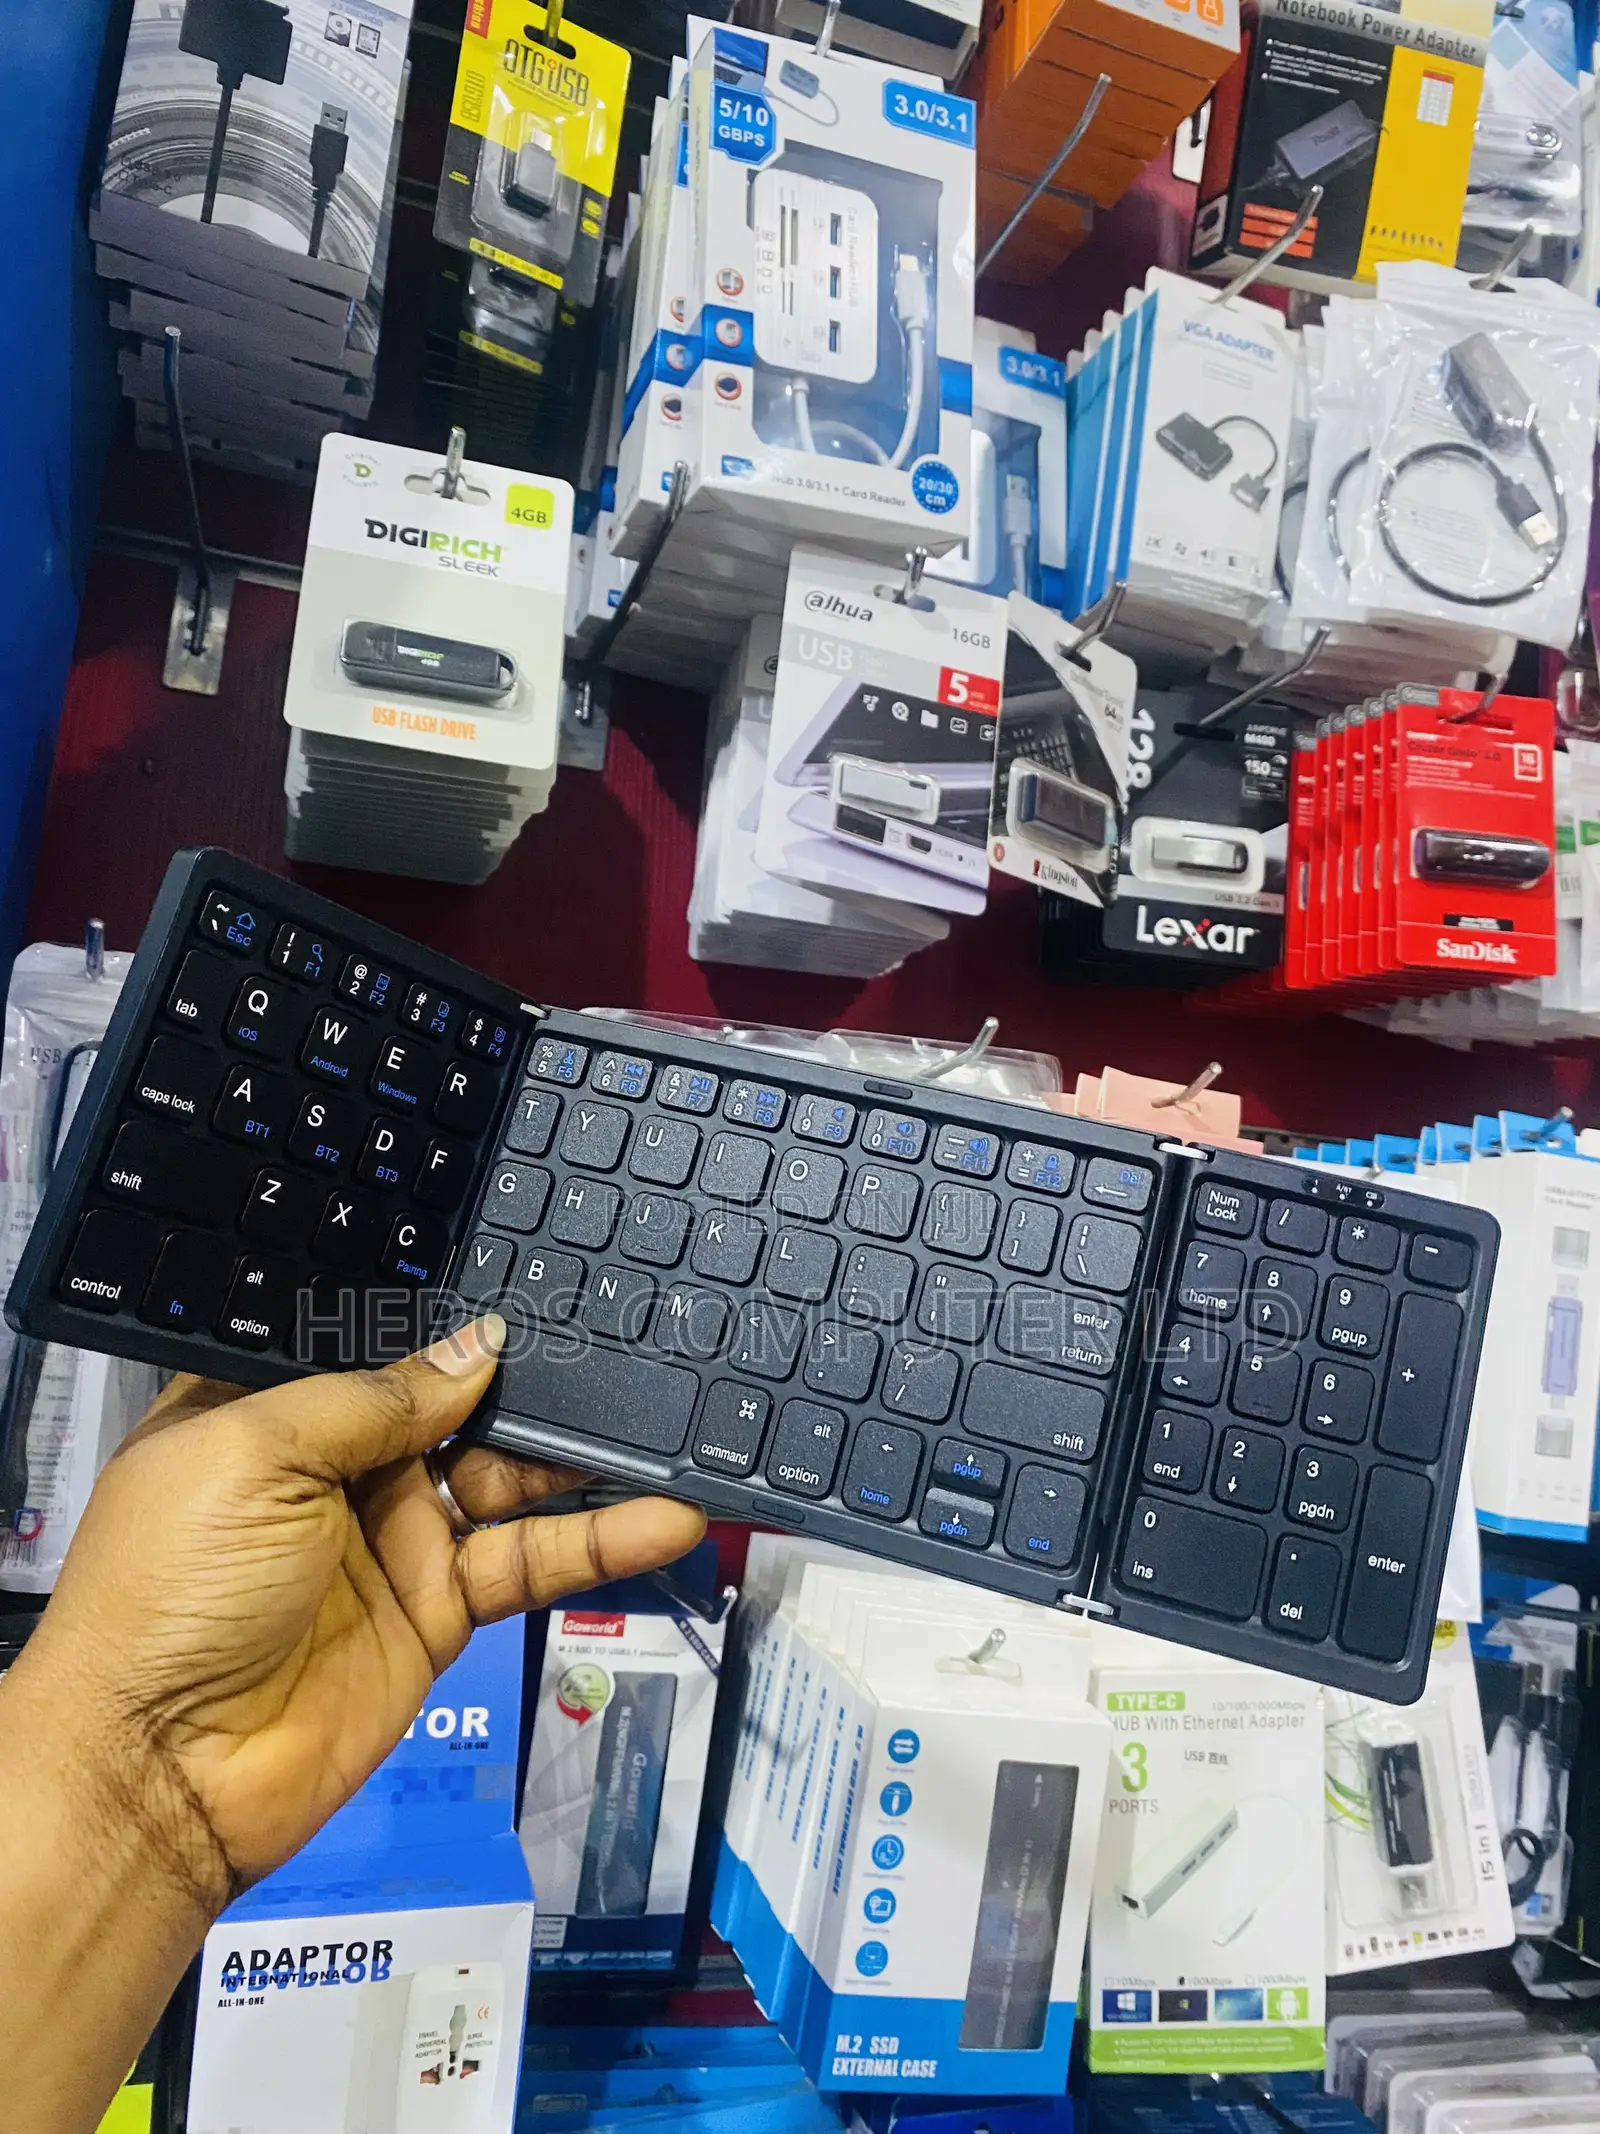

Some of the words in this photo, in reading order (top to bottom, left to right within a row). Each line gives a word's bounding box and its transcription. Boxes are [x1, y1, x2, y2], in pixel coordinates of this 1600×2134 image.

[1276, 0, 1357, 28] Notebook
[1362, 13, 1410, 40] Power
[1413, 27, 1476, 59] Adapter
[718, 96, 769, 127] 5/10
[894, 94, 968, 133] 3.0/3.1
[718, 125, 766, 147] GBPS
[1183, 319, 1213, 340] VGA
[842, 486, 867, 500] Card
[510, 506, 547, 524] 4GB
[365, 518, 502, 562] DIGIRICH
[438, 556, 499, 577] SLEEK
[952, 627, 992, 649] 16GB
[797, 632, 855, 671] USB
[947, 671, 970, 704] 5
[372, 706, 396, 727] USB
[401, 711, 439, 734] FLASH
[440, 717, 477, 740] DRIVE
[1244, 759, 1271, 777] 150
[1040, 863, 1079, 889] Kingston
[1214, 892, 1233, 902] USB
[226, 926, 251, 947] Esc
[1136, 905, 1255, 954] Lexar
[282, 951, 290, 964] 1
[1436, 937, 1518, 965] SanDisk
[304, 961, 320, 977] F1
[349, 980, 361, 995] 2
[175, 999, 198, 1017] tab
[248, 990, 269, 1016] Q
[369, 990, 385, 1006] F2
[410, 1008, 421, 1022] 3
[323, 1017, 348, 1045] W
[430, 1018, 446, 1033] F3
[469, 1034, 478, 1047] 4
[487, 1043, 502, 1058] F4
[31, 1047, 61, 1064] USB
[386, 1046, 406, 1070] E
[311, 1055, 349, 1078] Android
[538, 1060, 548, 1074] 5
[557, 1064, 573, 1078] F5
[233, 1078, 253, 1102] A
[450, 1073, 468, 1096] R
[601, 1074, 611, 1087] 6
[620, 1079, 637, 1093] F6
[141, 1086, 171, 1103] caps
[171, 1094, 195, 1113] lock
[378, 1081, 418, 1105] Windows
[668, 1088, 677, 1101] 7
[687, 1093, 703, 1107] F7
[307, 1104, 326, 1127] S
[526, 1100, 540, 1120] T
[733, 1103, 743, 1116] 8
[755, 1109, 772, 1122] F8
[244, 1119, 270, 1138] BT1
[580, 1111, 597, 1132] Y
[802, 1118, 811, 1131] 9
[824, 1123, 842, 1137] F9
[375, 1129, 394, 1152] D
[646, 1126, 664, 1147] U
[871, 1133, 882, 1147] 0
[887, 1138, 914, 1154] F10
[315, 1144, 340, 1163] BT2
[431, 1150, 448, 1170] F
[717, 1143, 725, 1162] I
[962, 1155, 988, 1170] F11
[110, 1168, 143, 1191] shift
[375, 1166, 399, 1183] BT3
[789, 1160, 809, 1181] O
[1035, 1171, 1062, 1187] F12
[1119, 1170, 1142, 1184] Del
[260, 1179, 282, 1203] Z
[498, 1173, 516, 1193] G
[861, 1175, 880, 1195] P
[565, 1187, 584, 1210] H
[1208, 1190, 1240, 1208] Num
[332, 1202, 353, 1226] X
[636, 1205, 651, 1225] J
[1206, 1203, 1237, 1222] Lock
[398, 1225, 416, 1247] C
[707, 1220, 727, 1244] K
[476, 1247, 493, 1267] V
[779, 1238, 793, 1260] L
[396, 1259, 428, 1280] Pairing
[527, 1259, 545, 1281] B
[1196, 1252, 1209, 1269] 7
[70, 1275, 121, 1300] control
[246, 1269, 264, 1286] alt
[1267, 1271, 1280, 1287] 8
[598, 1277, 618, 1300] N
[1339, 1289, 1352, 1306] 9
[170, 1300, 184, 1315] fn
[670, 1295, 694, 1320] M
[1189, 1289, 1227, 1310] home
[230, 1317, 270, 1337] option
[1073, 1310, 1110, 1331] enter
[1178, 1336, 1191, 1352] 4
[1331, 1326, 1367, 1347] pgup
[1062, 1344, 1102, 1366] return
[1250, 1355, 1263, 1371] 5
[1323, 1374, 1336, 1391] 6
[813, 1422, 831, 1439] alt
[1162, 1423, 1171, 1439] 1
[1052, 1431, 1085, 1451] shift
[1232, 1441, 1246, 1457] 2
[700, 1442, 749, 1466] command
[778, 1463, 819, 1486] option
[953, 1461, 982, 1479] pgup
[1153, 1461, 1180, 1479] end
[1306, 1460, 1319, 1477] 3
[860, 1487, 890, 1505] home
[1143, 1511, 1157, 1528] 0
[1298, 1501, 1336, 1521] pgdn
[939, 1520, 968, 1538] pgdn
[1028, 1536, 1049, 1551] end
[1132, 1562, 1153, 1579] ins
[1367, 1553, 1406, 1575] enter
[1279, 1601, 1303, 1621] del
[563, 1619, 618, 1635] Goworld
[1115, 1693, 1177, 1710] TYPE-C
[1146, 1714, 1178, 1731] With
[1183, 1714, 1244, 1731] Ethernet
[1248, 1714, 1305, 1731] Adapter
[1184, 1749, 1205, 1762] USB
[1121, 1742, 1148, 1793] 3
[1109, 1799, 1160, 1814] PORTS
[832, 1858, 845, 1898] CASE
[222, 1939, 393, 1973] ADAPTOR
[220, 1969, 351, 1988] INTERNATIONAL
[217, 1996, 265, 2008] ALL-IN-ONE
[836, 2033, 863, 2054] M.2
[869, 2035, 900, 2055] SSD
[832, 2056, 899, 2077] EXTERNAL
[901, 2058, 938, 2078] CASE
